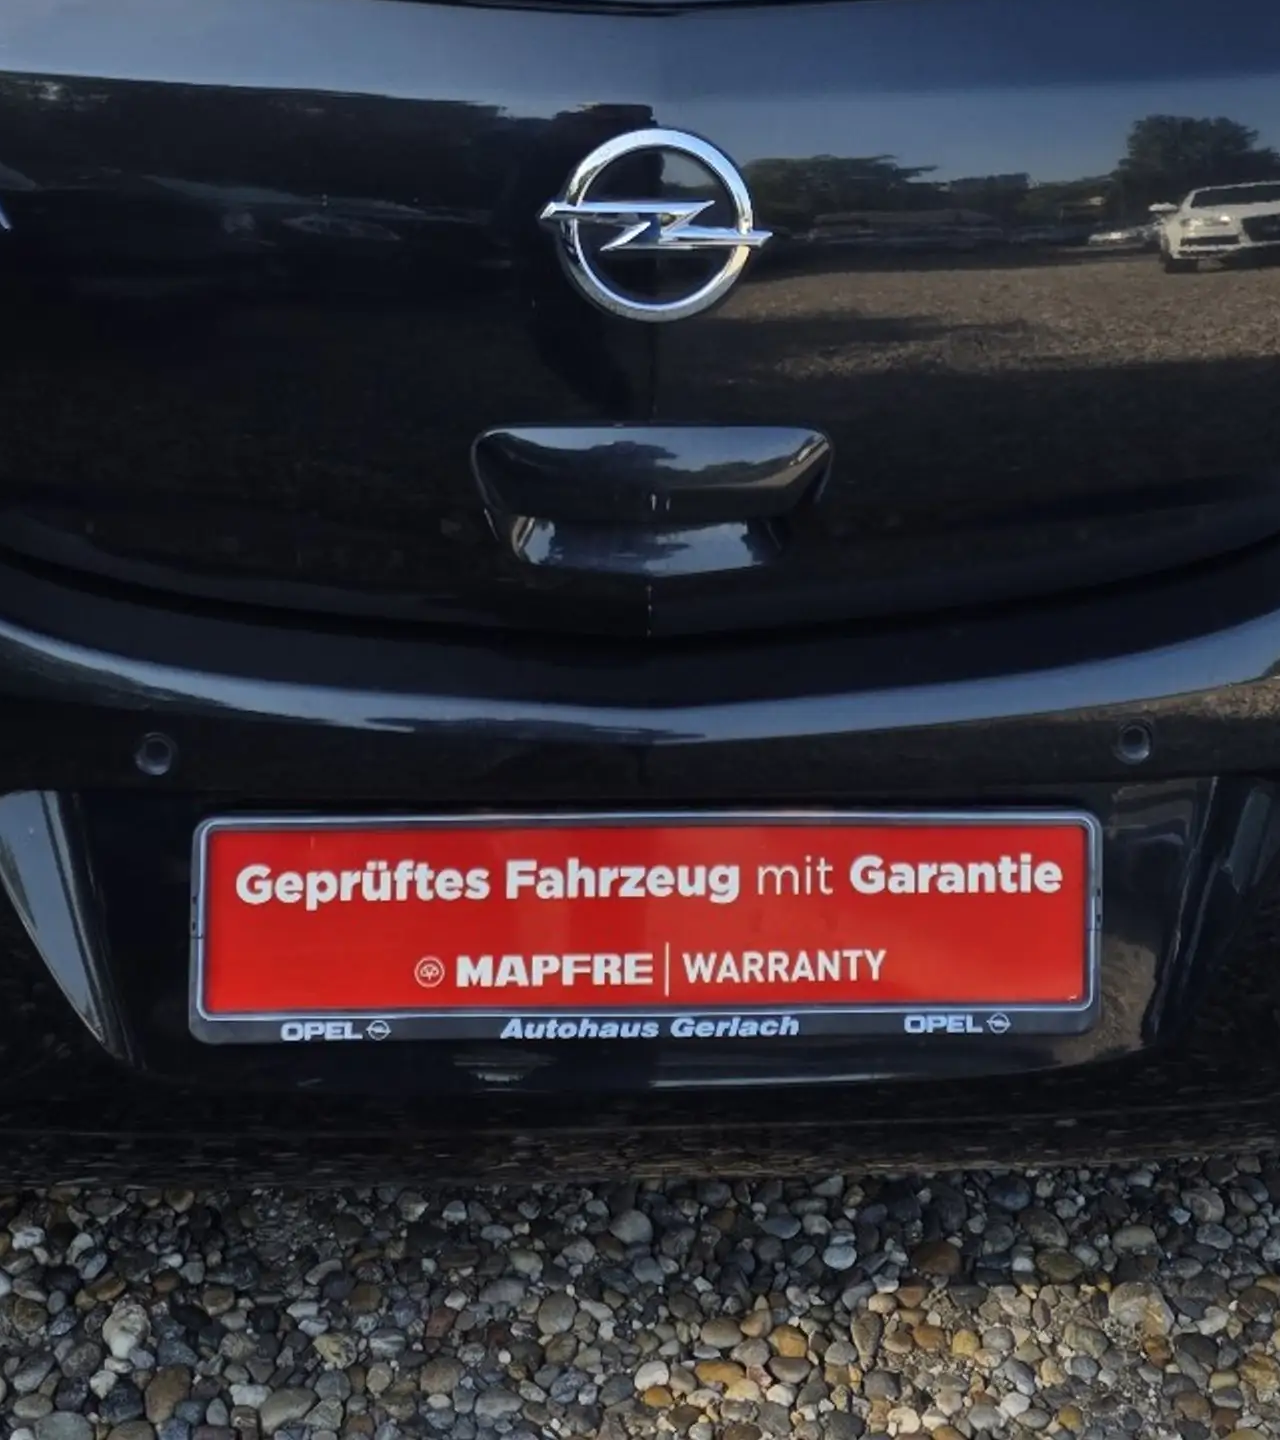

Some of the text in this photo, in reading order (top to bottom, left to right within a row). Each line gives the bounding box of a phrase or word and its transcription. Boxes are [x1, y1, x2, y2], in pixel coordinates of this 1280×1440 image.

[235, 853, 1063, 911] Geprüftes Fahrzeug mit Garantie
[456, 949, 887, 988] MAPFRE WARRANTY
[280, 1014, 984, 1042] OPEL Autohaus Gerlach OPEL
